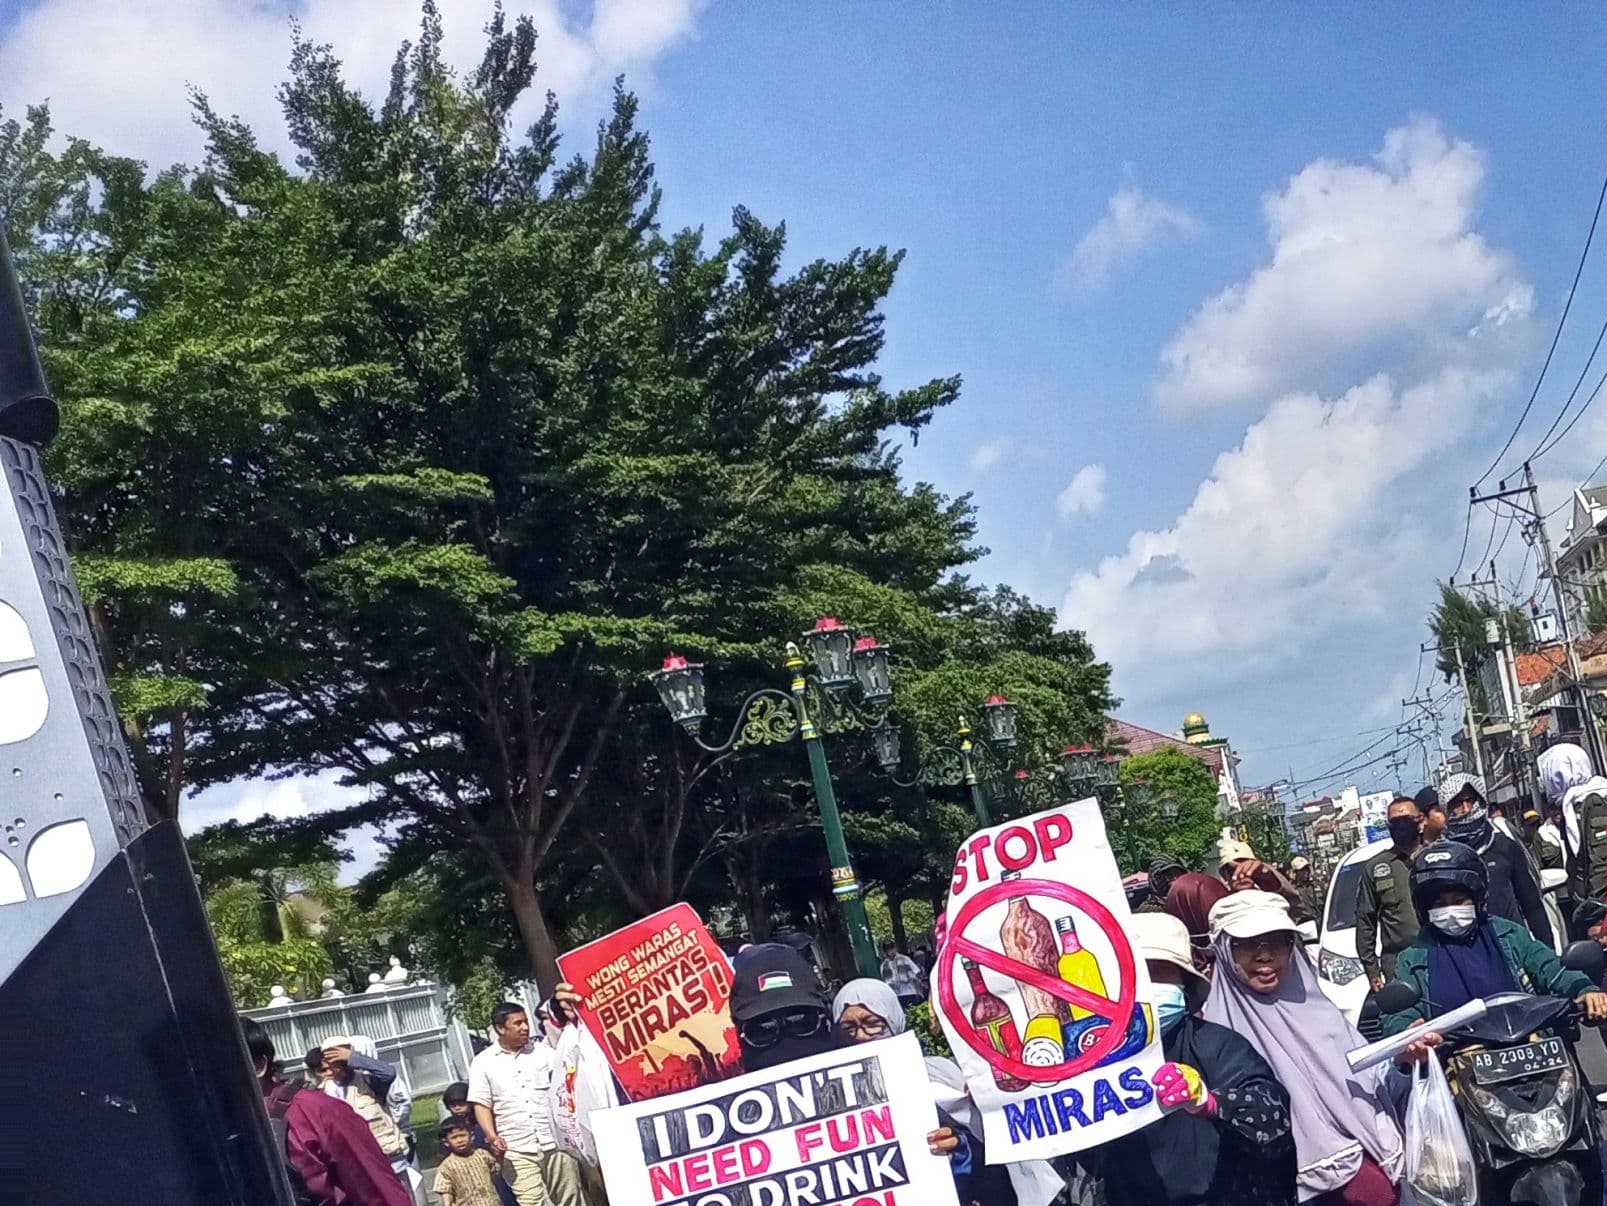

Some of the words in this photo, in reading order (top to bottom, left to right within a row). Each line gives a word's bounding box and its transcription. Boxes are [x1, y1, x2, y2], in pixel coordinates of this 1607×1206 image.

[952, 813, 1073, 895] STOP
[585, 979, 627, 1011] MESTI
[628, 930, 699, 984] SEMANGAT
[586, 953, 630, 989] WONG
[631, 922, 682, 962] WARAS
[599, 949, 707, 1029] BERANTAS
[1476, 1054, 1492, 1067] AB
[1539, 1041, 1559, 1056] YD
[653, 1114, 673, 1158] I
[684, 1063, 863, 1150] DON'T
[1003, 1066, 1154, 1144] MIRAS
[649, 1138, 771, 1201] NEED
[795, 1105, 895, 1163] FUN
